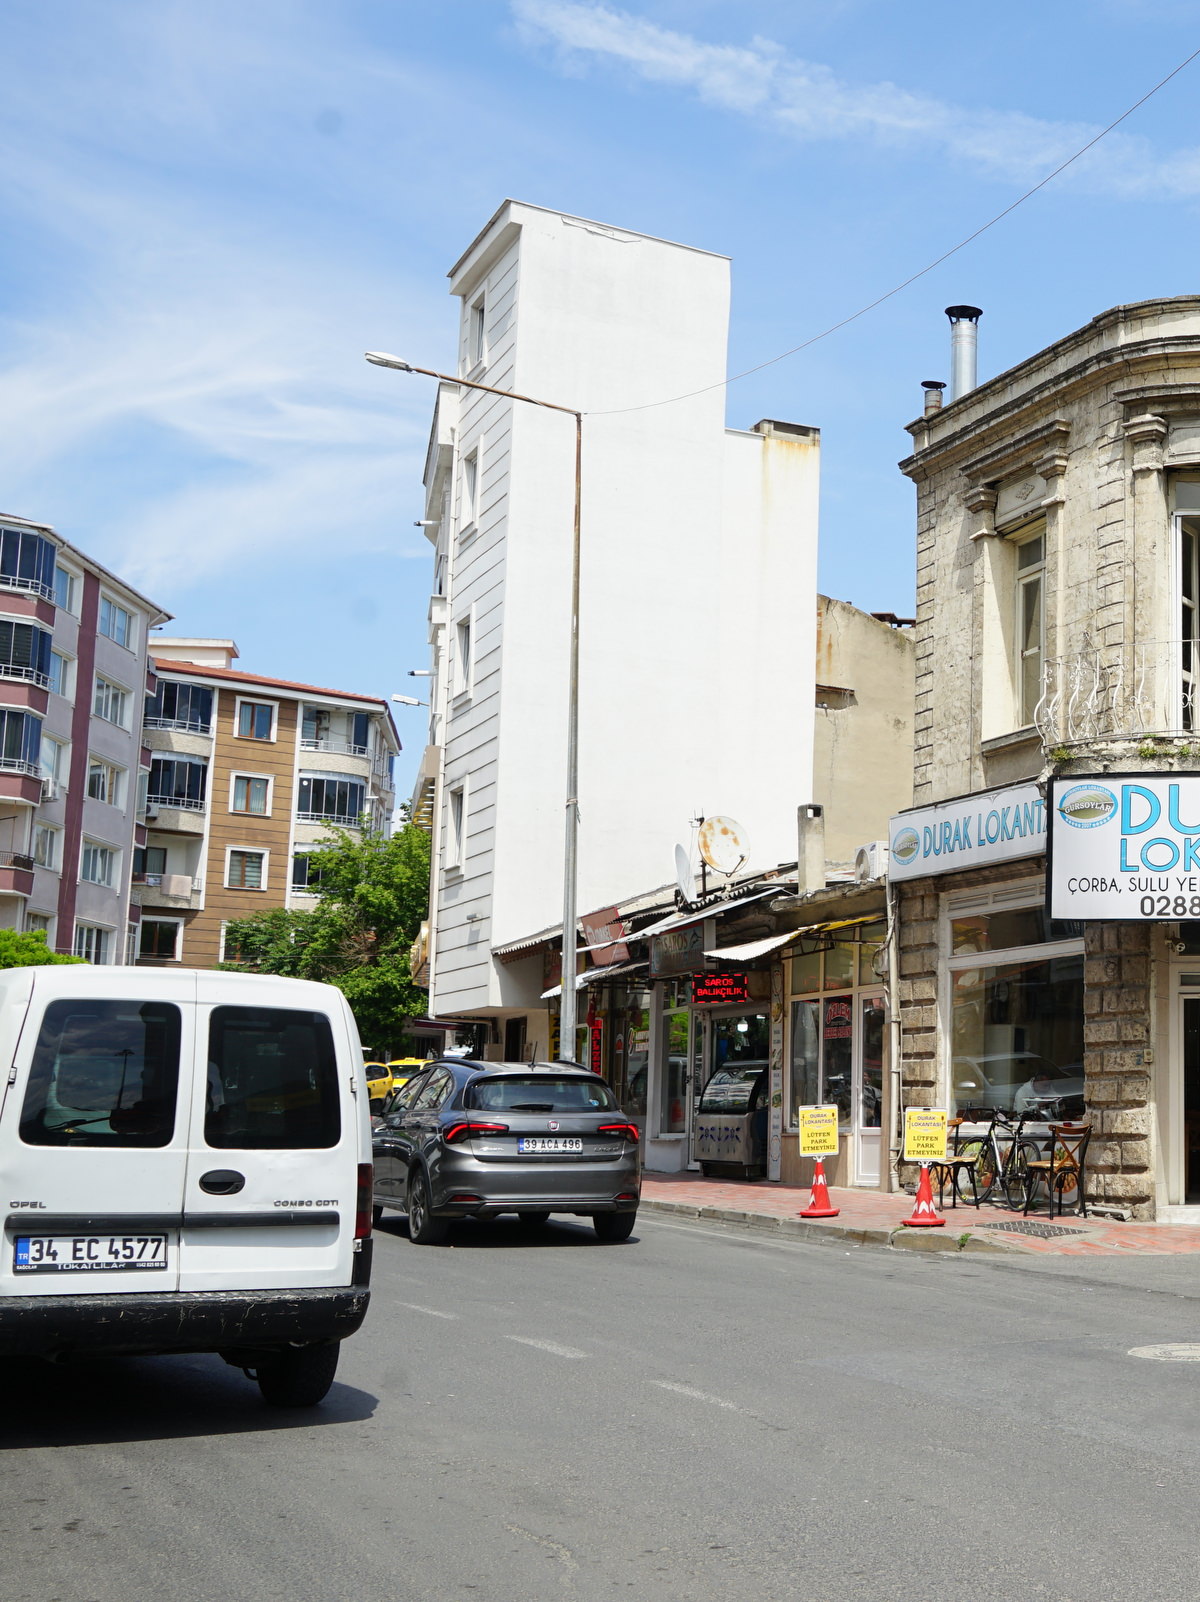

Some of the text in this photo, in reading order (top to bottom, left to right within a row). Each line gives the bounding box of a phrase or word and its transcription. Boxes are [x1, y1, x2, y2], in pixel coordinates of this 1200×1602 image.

[923, 799, 1048, 859] DURAK LOKANT
[1067, 877, 1123, 895] ÇORBA,
[1128, 877, 1169, 892] SULU
[704, 978, 734, 986] SAROS
[697, 987, 743, 998] BALIKÇILIK
[525, 1139, 581, 1149] 39 ACA 496
[802, 1144, 836, 1152] ETMEYİNİZ
[9, 1201, 47, 1209] OPEL
[273, 1199, 313, 1207] COMBO
[31, 1237, 163, 1262] 34 EC 4577
